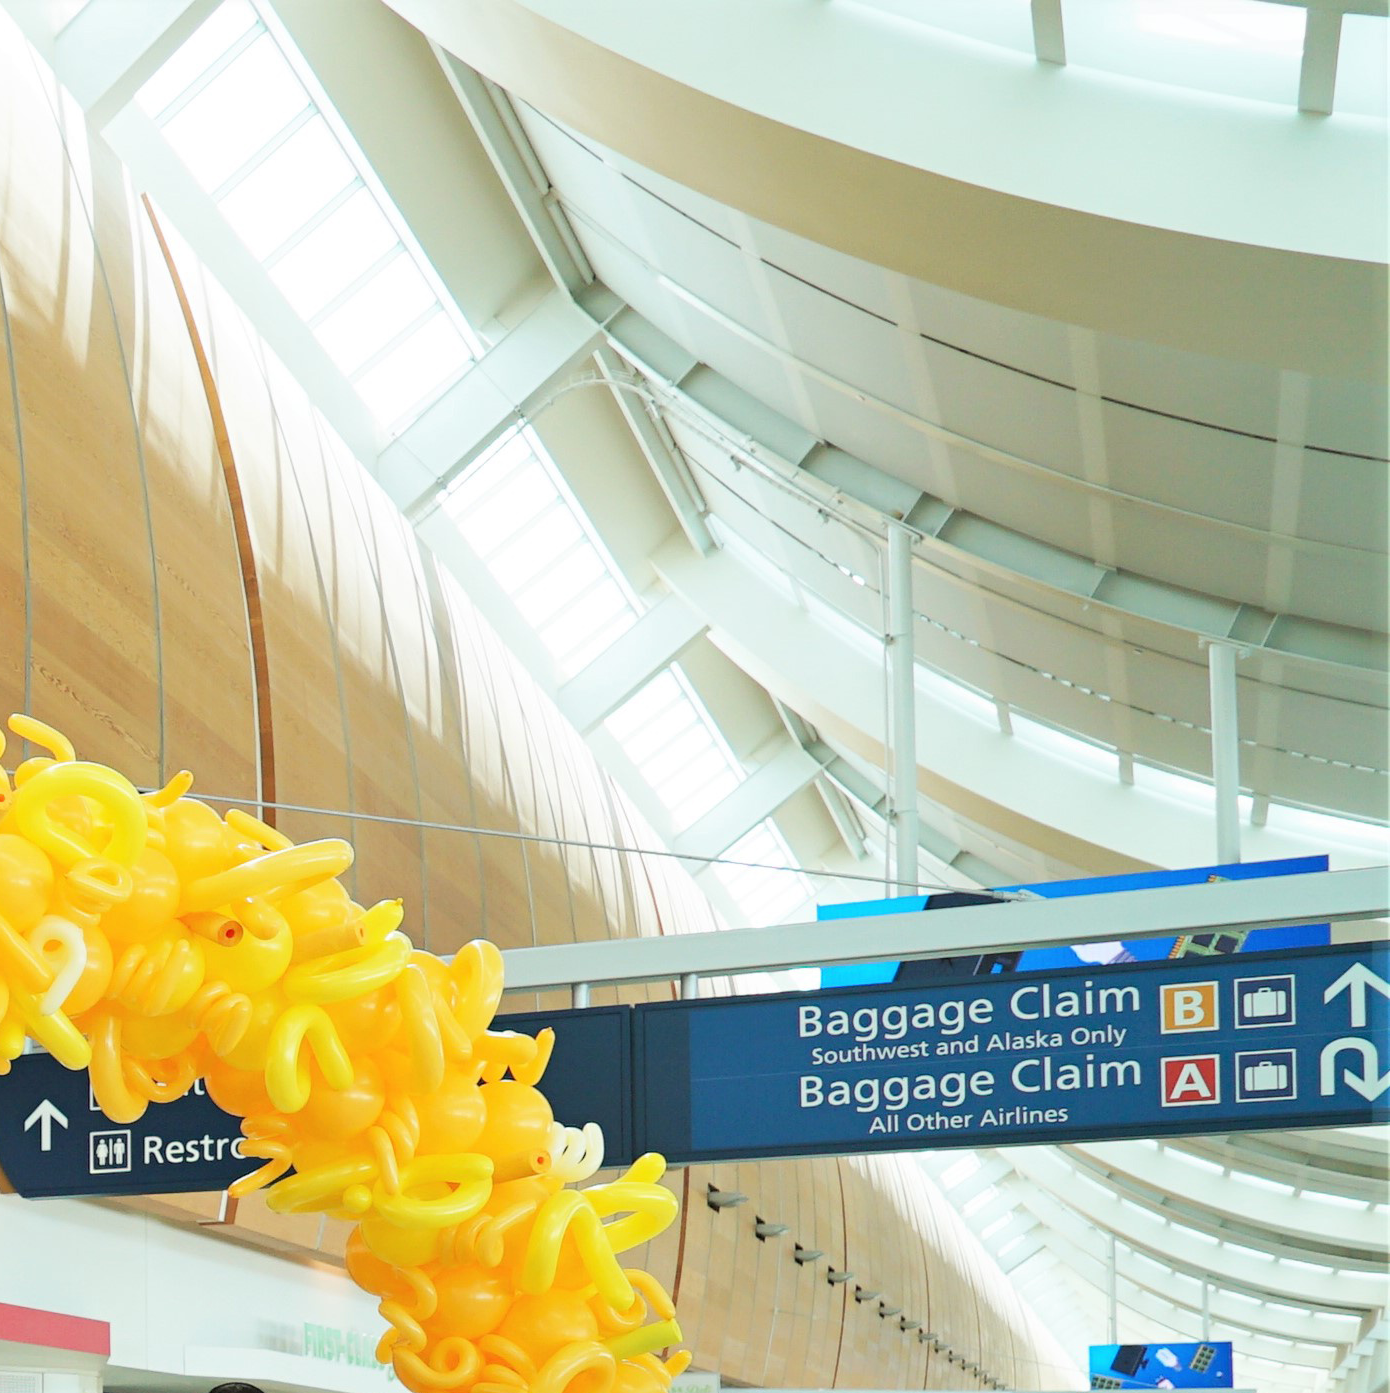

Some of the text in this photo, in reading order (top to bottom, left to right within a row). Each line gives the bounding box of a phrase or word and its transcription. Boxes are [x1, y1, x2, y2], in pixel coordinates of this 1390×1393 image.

[798, 981, 1205, 1042] Baggage Claim B
[811, 1024, 1128, 1066] Southwest and Alaska Only
[799, 1054, 1213, 1113] Baggage Claim A
[868, 1106, 1070, 1135] All Other Airlines
[143, 1133, 250, 1166] Restro
